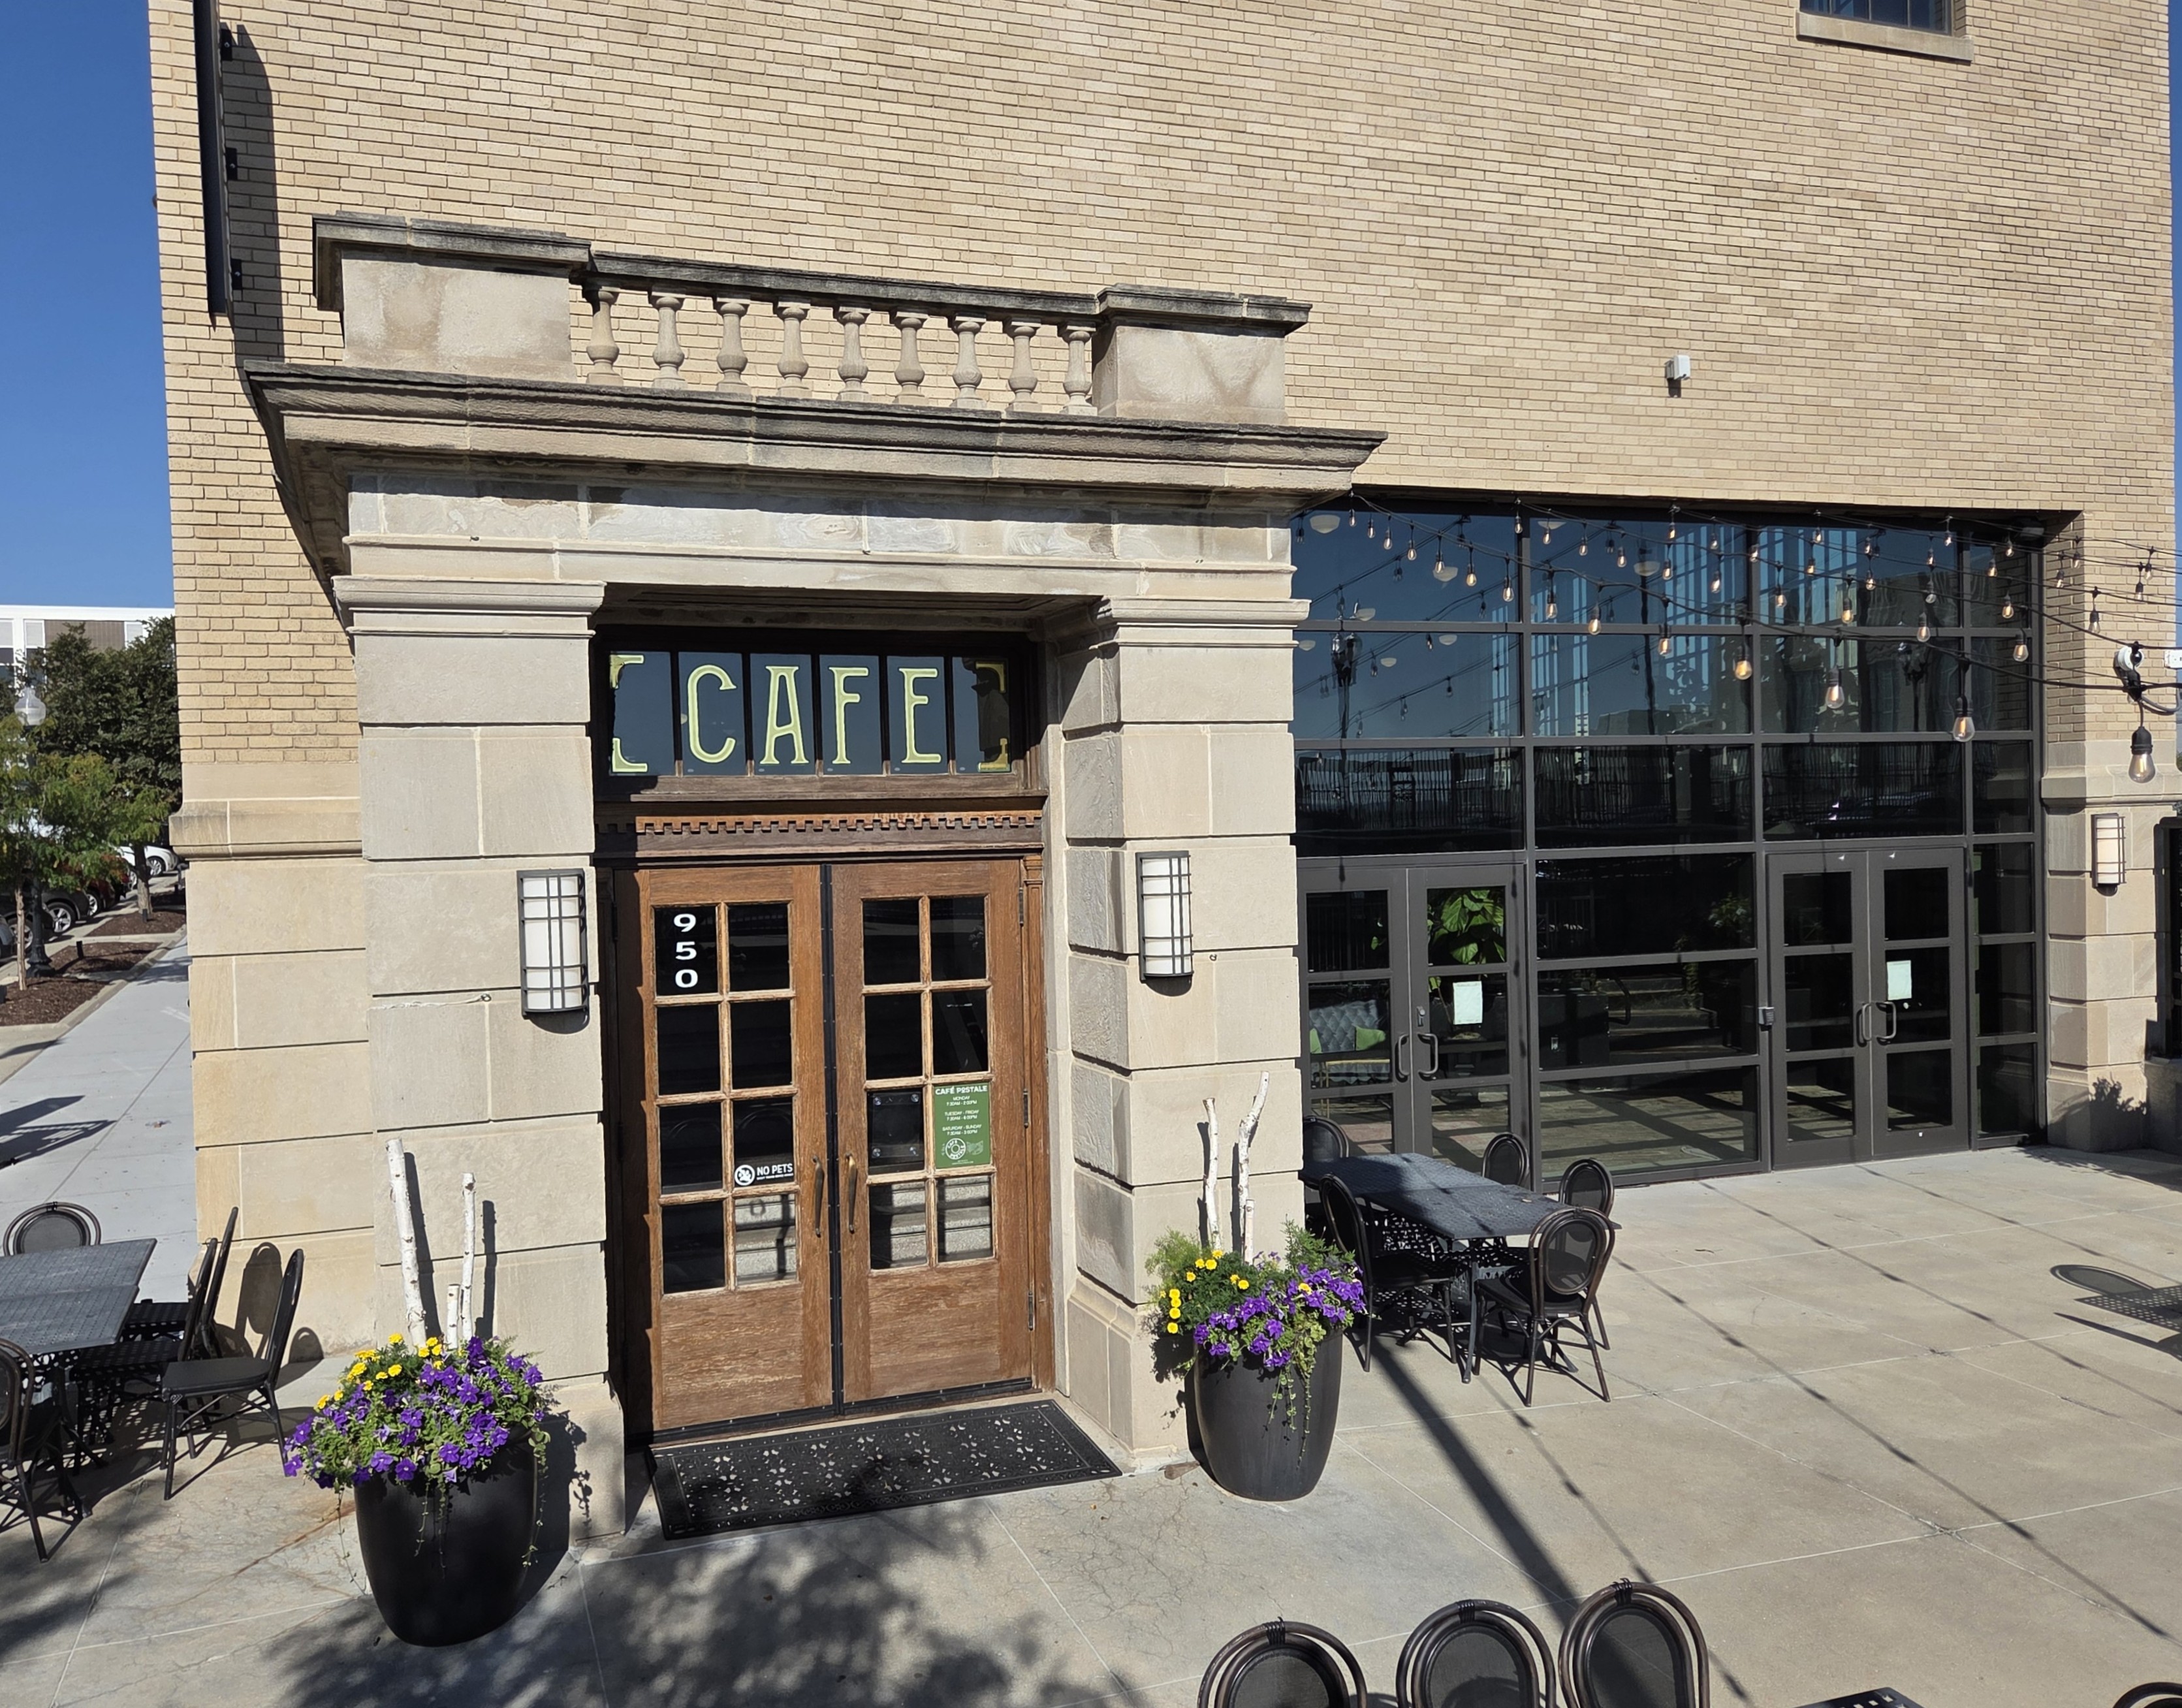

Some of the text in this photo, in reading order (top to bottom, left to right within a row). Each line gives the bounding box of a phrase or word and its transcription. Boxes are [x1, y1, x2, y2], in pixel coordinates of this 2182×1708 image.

[687, 664, 941, 764] CAFE
[935, 1086, 955, 1095] CAFÉ
[757, 1163, 793, 1176] NO PETS
